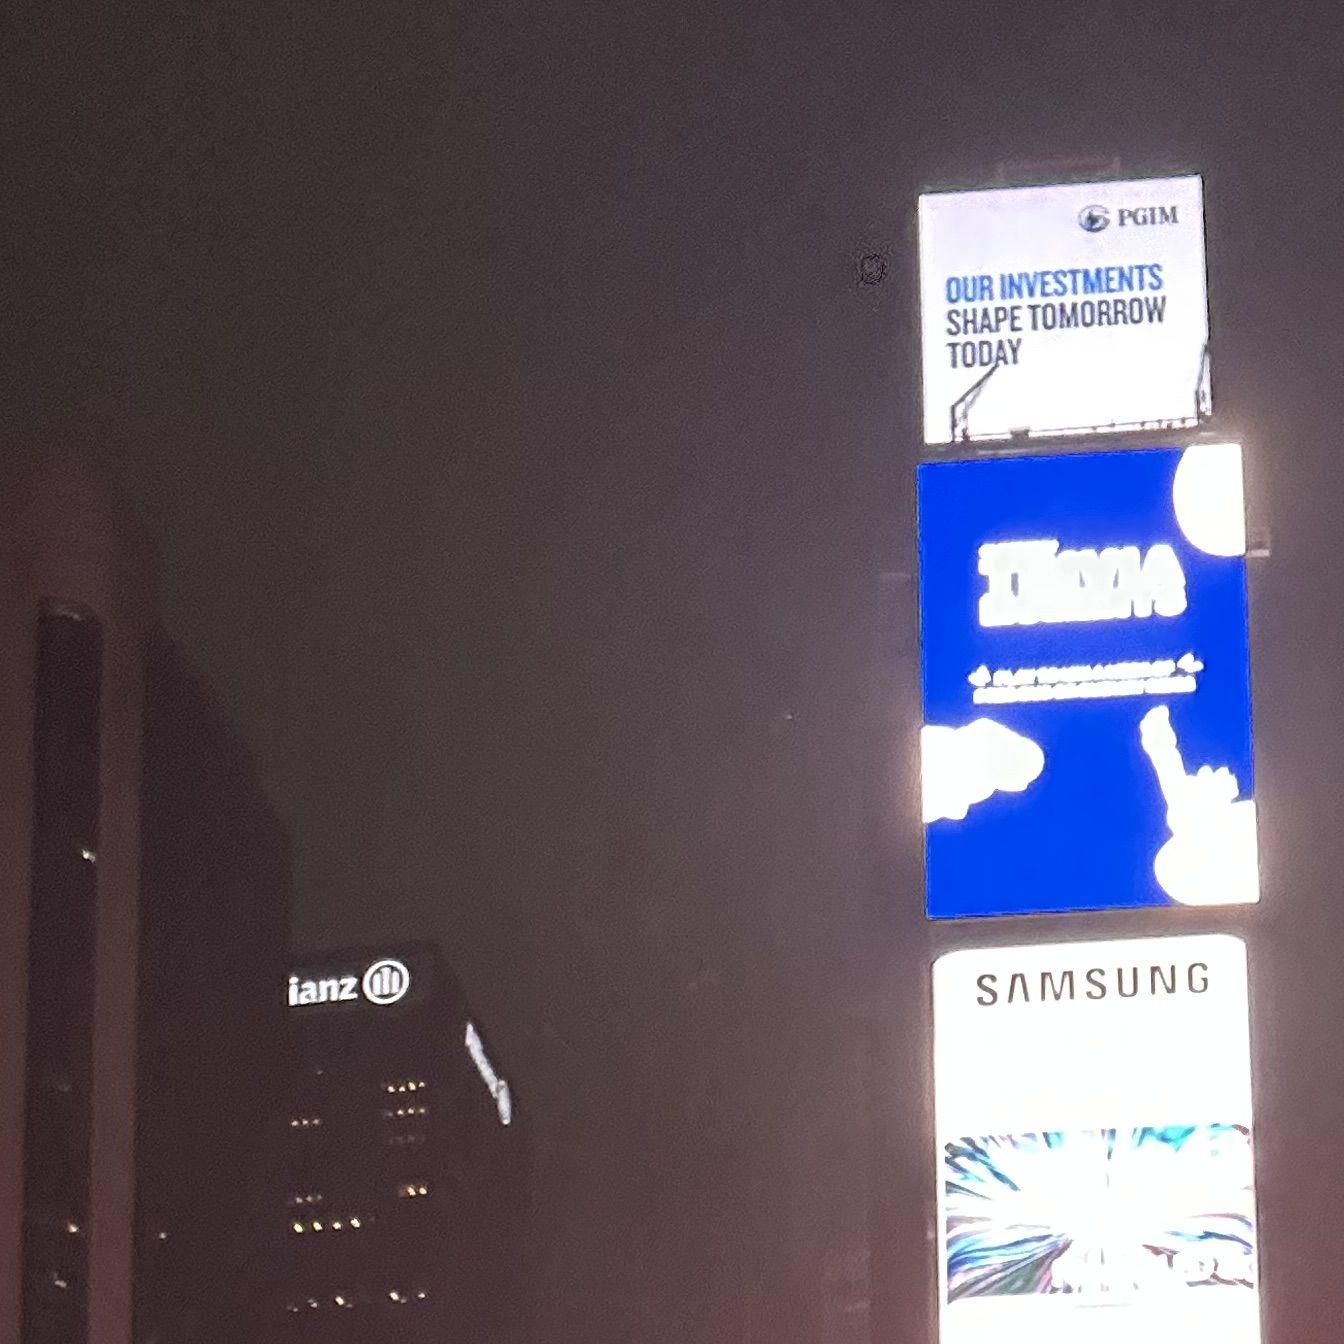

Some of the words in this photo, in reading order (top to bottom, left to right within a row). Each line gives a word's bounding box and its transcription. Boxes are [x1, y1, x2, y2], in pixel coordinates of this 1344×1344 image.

[1118, 206, 1178, 227] PGIM
[946, 275, 993, 303] OUR
[1000, 263, 1164, 299] INVESTMENTS
[946, 305, 1022, 336] SHAPE
[1028, 295, 1166, 330] TOMORROW
[946, 338, 1021, 369] TODAY
[976, 962, 1209, 1006] SAMSUNG
